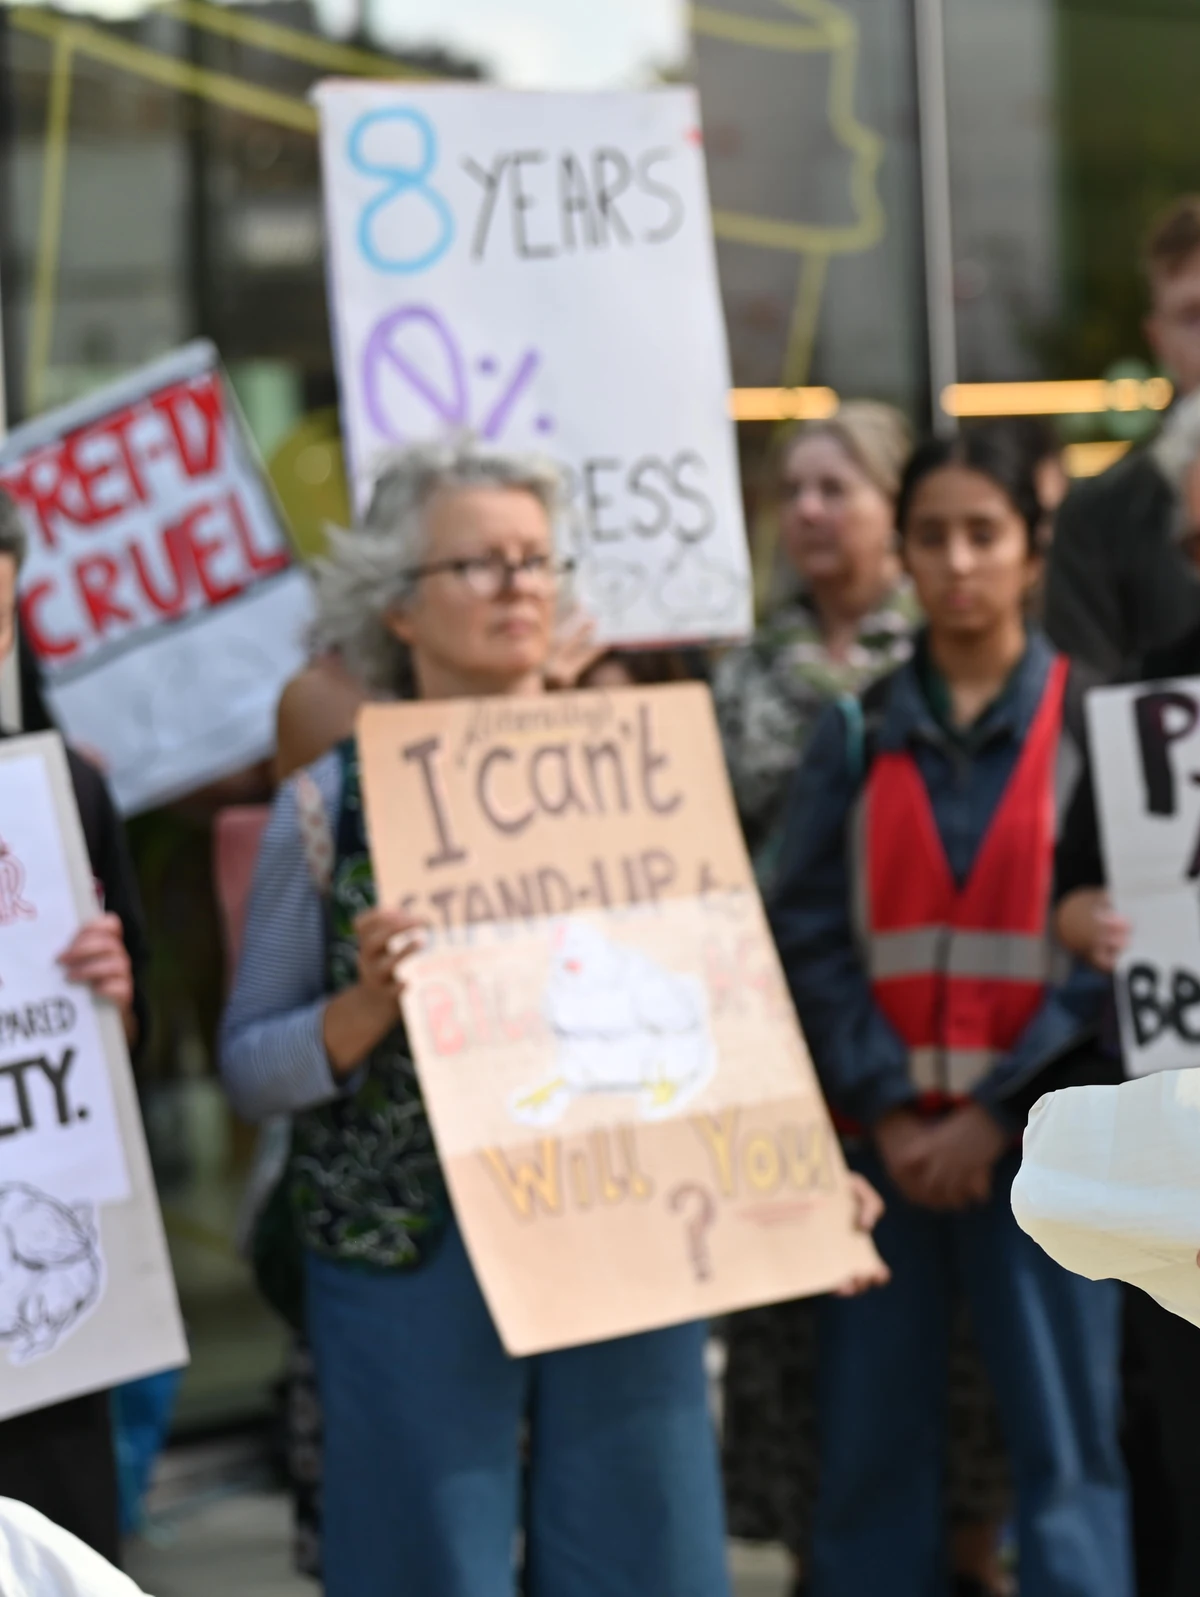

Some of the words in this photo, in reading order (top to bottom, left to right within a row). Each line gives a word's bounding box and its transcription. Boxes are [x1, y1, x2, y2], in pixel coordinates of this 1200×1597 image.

[347, 106, 455, 274] 8
[460, 147, 686, 263] YEARS
[19, 493, 293, 662] CRUEL
[404, 738, 467, 868] I
[477, 702, 684, 834] can't
[480, 1118, 653, 1222] Will
[668, 1179, 717, 1282] ?
